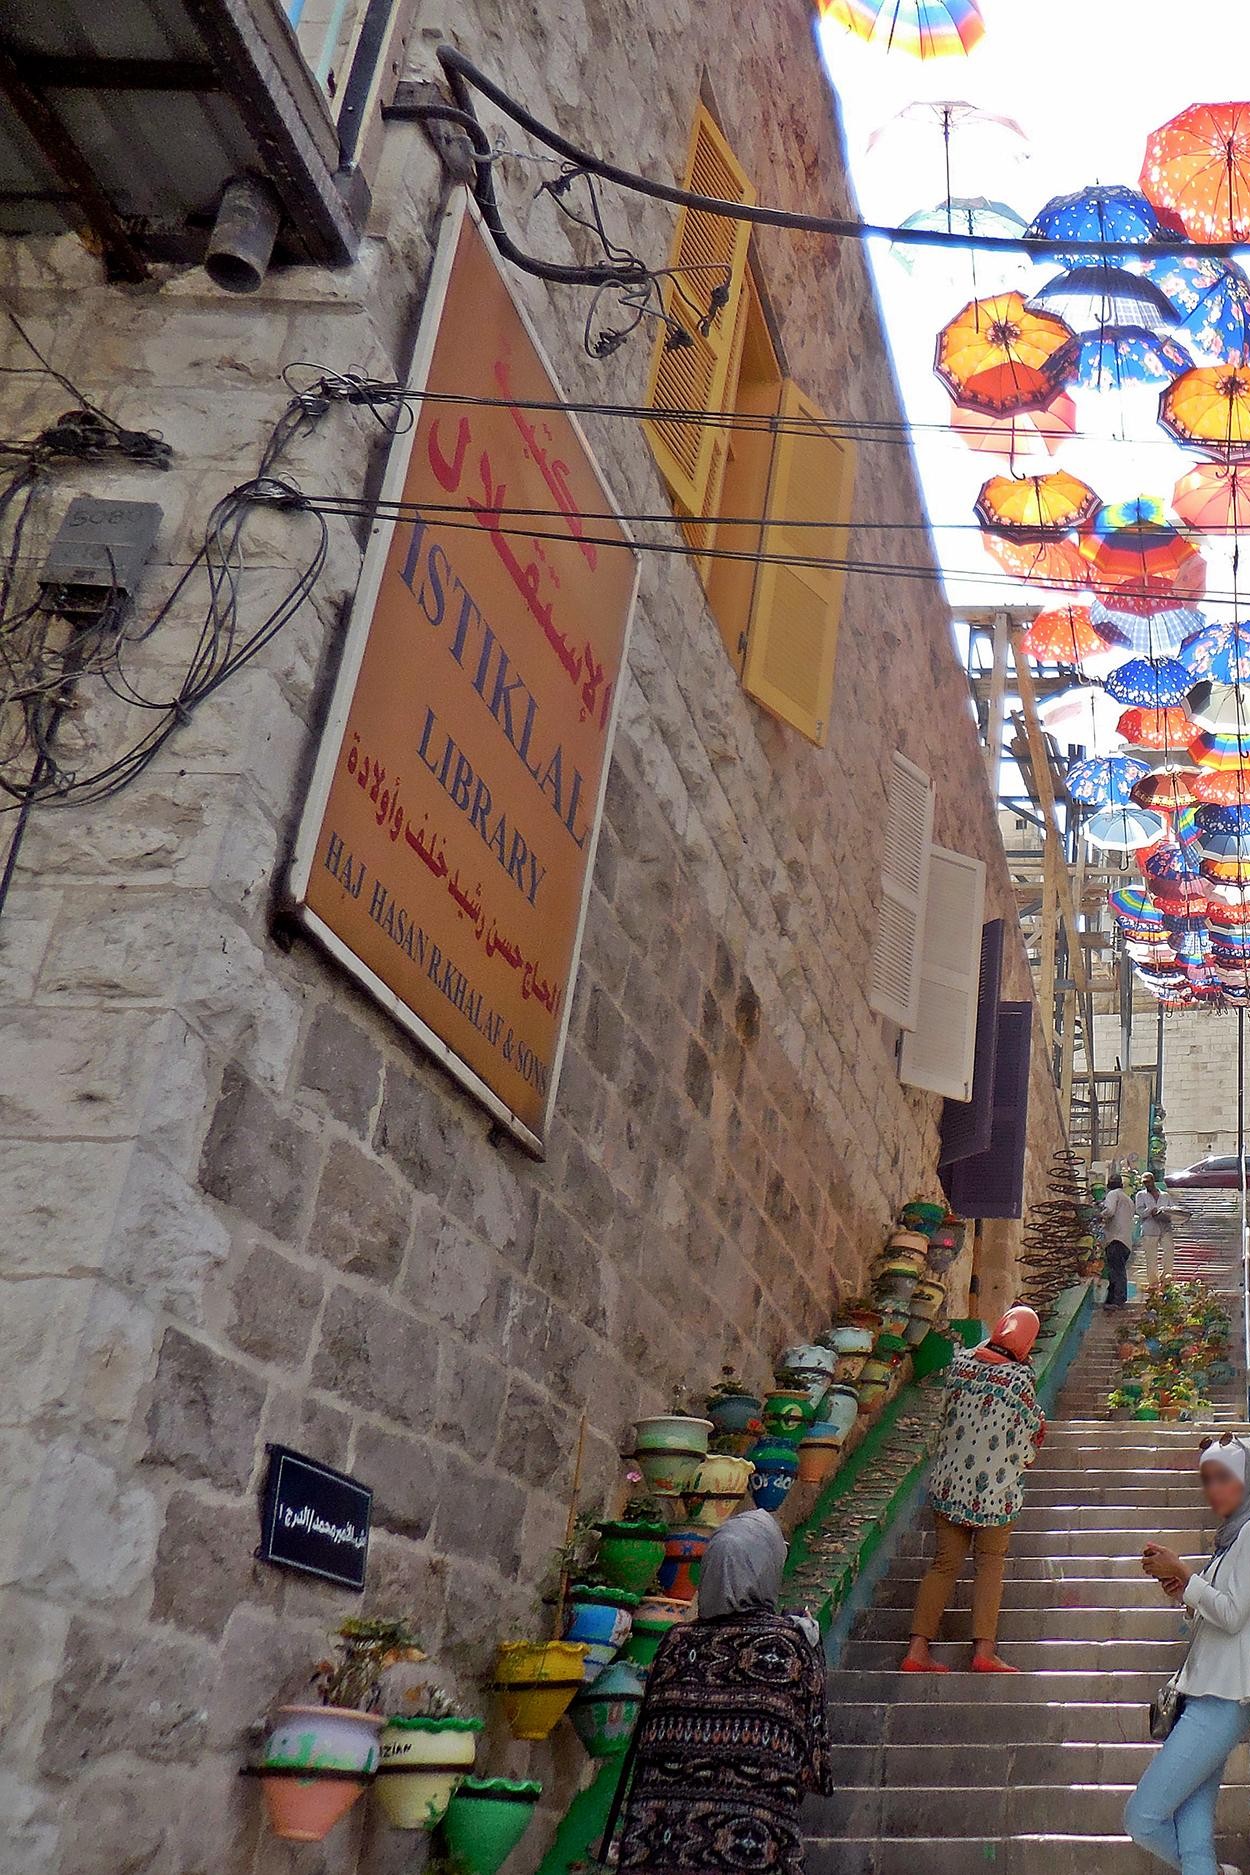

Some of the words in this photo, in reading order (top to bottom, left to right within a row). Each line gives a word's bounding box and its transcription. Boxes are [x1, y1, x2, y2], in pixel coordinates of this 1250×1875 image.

[493, 334, 597, 571] مكتبة
[398, 510, 591, 849] ISTIKLAL
[405, 814, 448, 879] خلف
[416, 706, 547, 908] LIBRARY
[323, 832, 367, 900] HAJ
[368, 879, 428, 967] HASAN
[515, 1035, 549, 1097] SONS
[448, 869, 485, 939] رشيد
[486, 924, 524, 969] حسن
[521, 959, 562, 1016] الحاج
